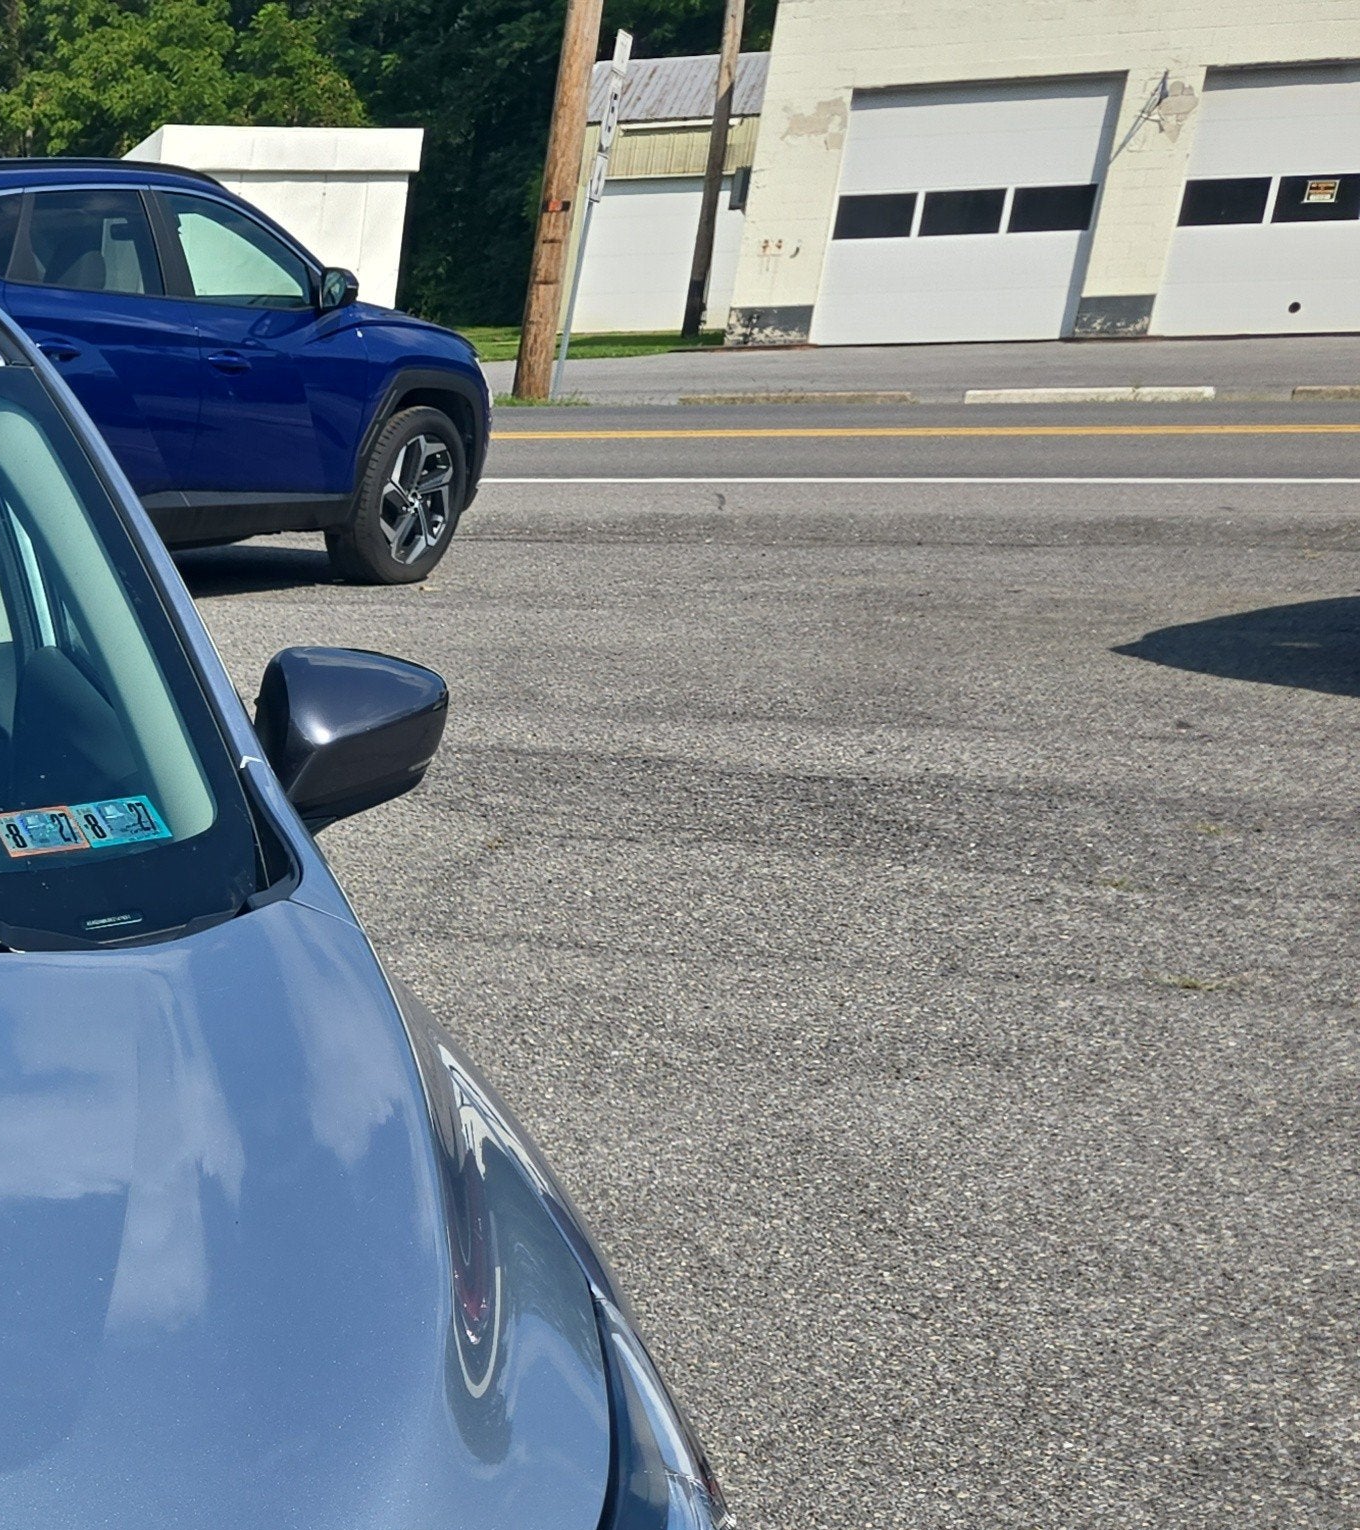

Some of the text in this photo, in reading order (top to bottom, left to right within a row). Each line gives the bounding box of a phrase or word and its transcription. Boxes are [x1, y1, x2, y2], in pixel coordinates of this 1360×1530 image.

[6, 813, 78, 848] 8 27
[84, 803, 157, 838] 8 27
